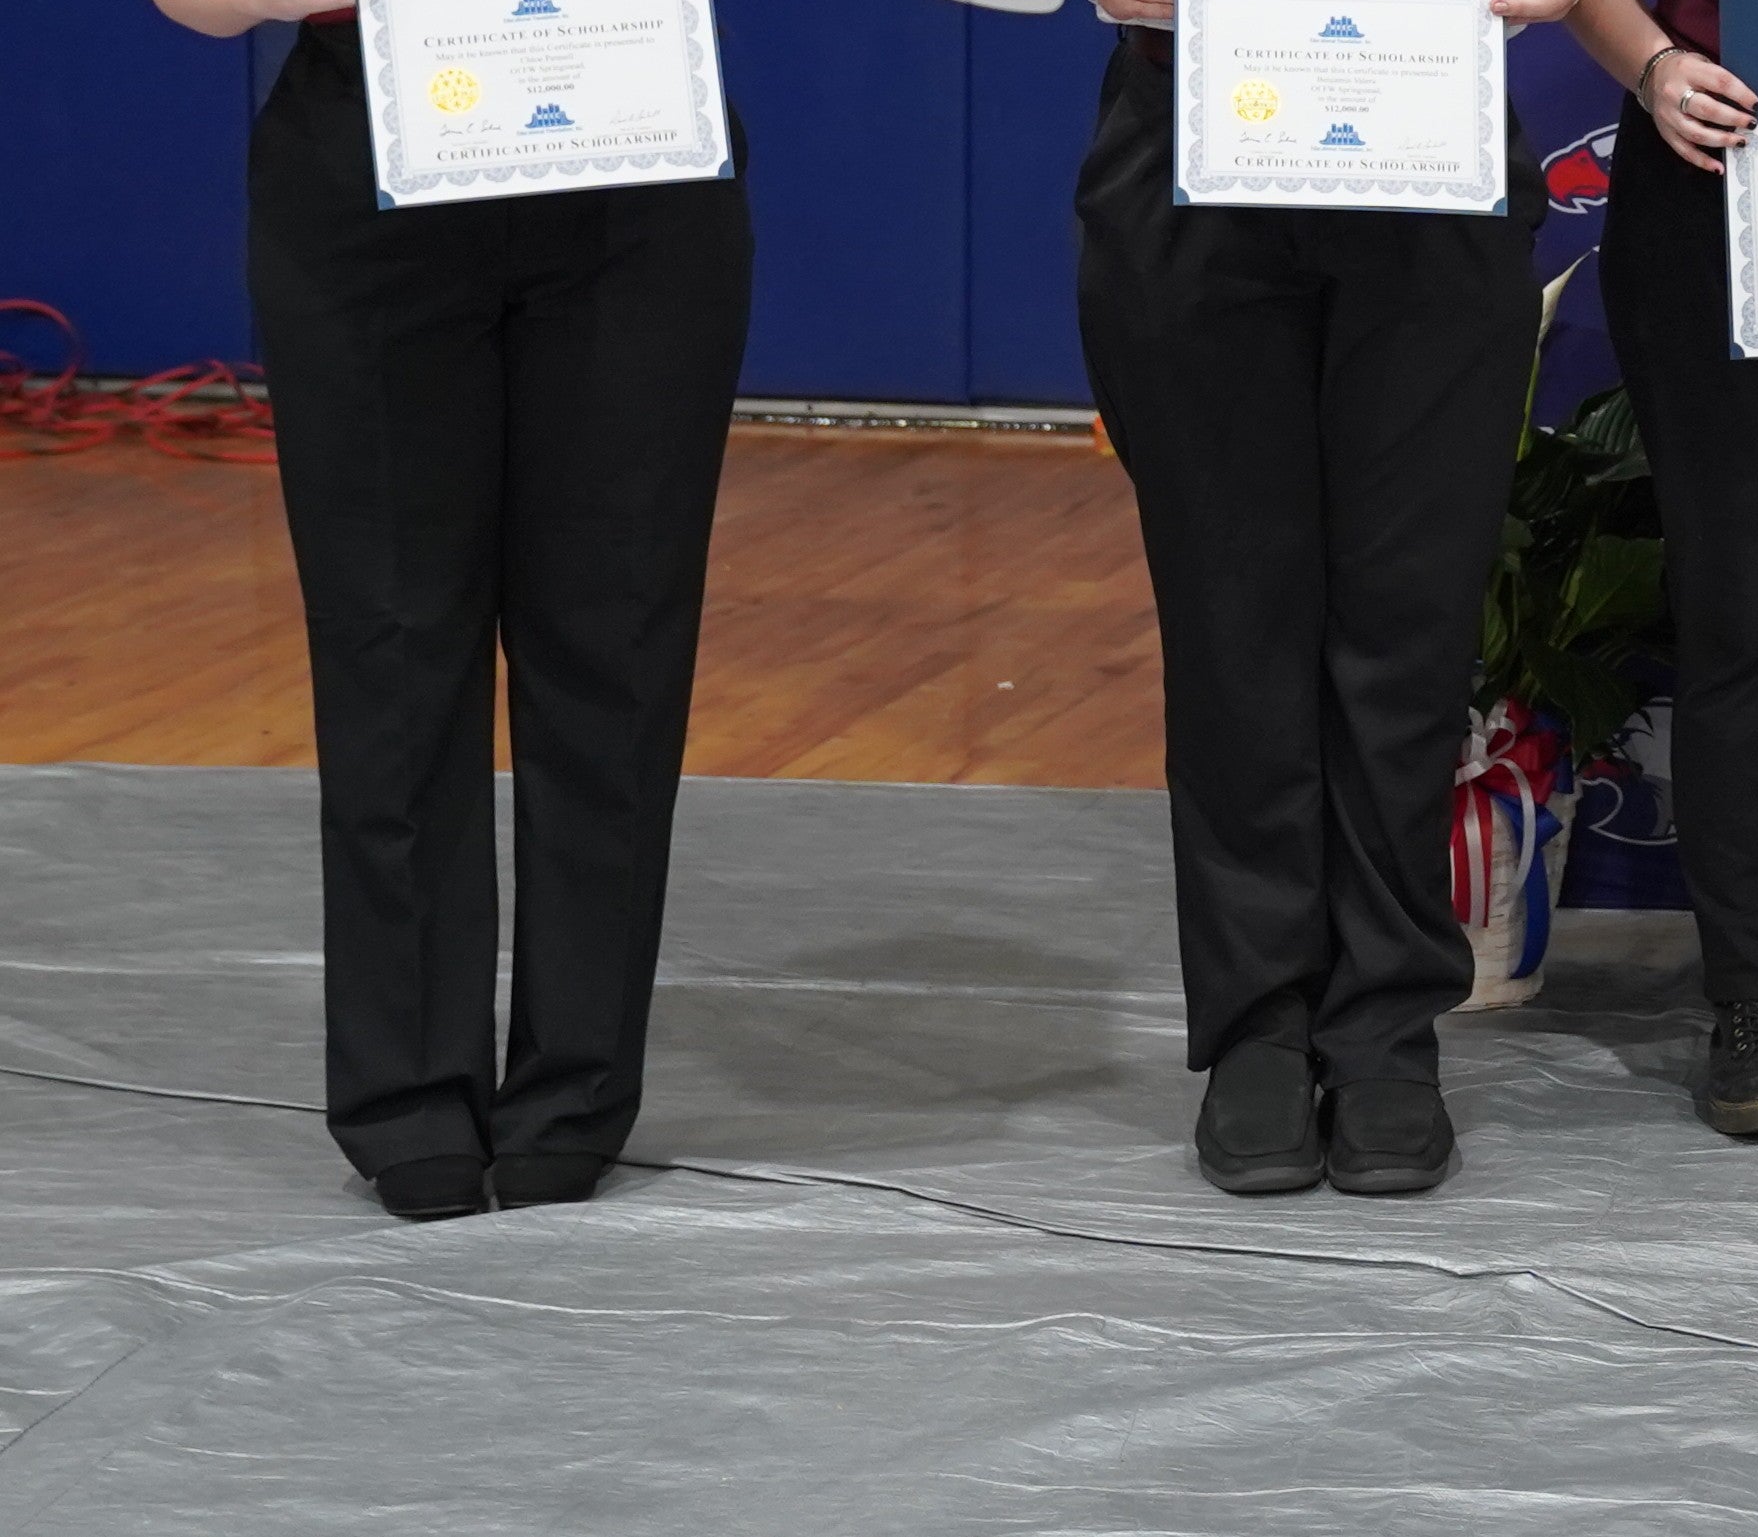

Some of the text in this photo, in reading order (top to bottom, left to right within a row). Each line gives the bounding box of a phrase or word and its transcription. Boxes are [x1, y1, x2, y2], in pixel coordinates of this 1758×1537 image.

[423, 19, 664, 48] CERTIFICATE OF SCHOLARSHIP
[1233, 46, 1459, 65] CERTIFICATE OF SCHOLARSHIP
[436, 129, 678, 162] CERTIFICATE OF SCHOLARSHIP
[1233, 155, 1461, 173] CERTIFICATE OF SCHOLARSHIP
